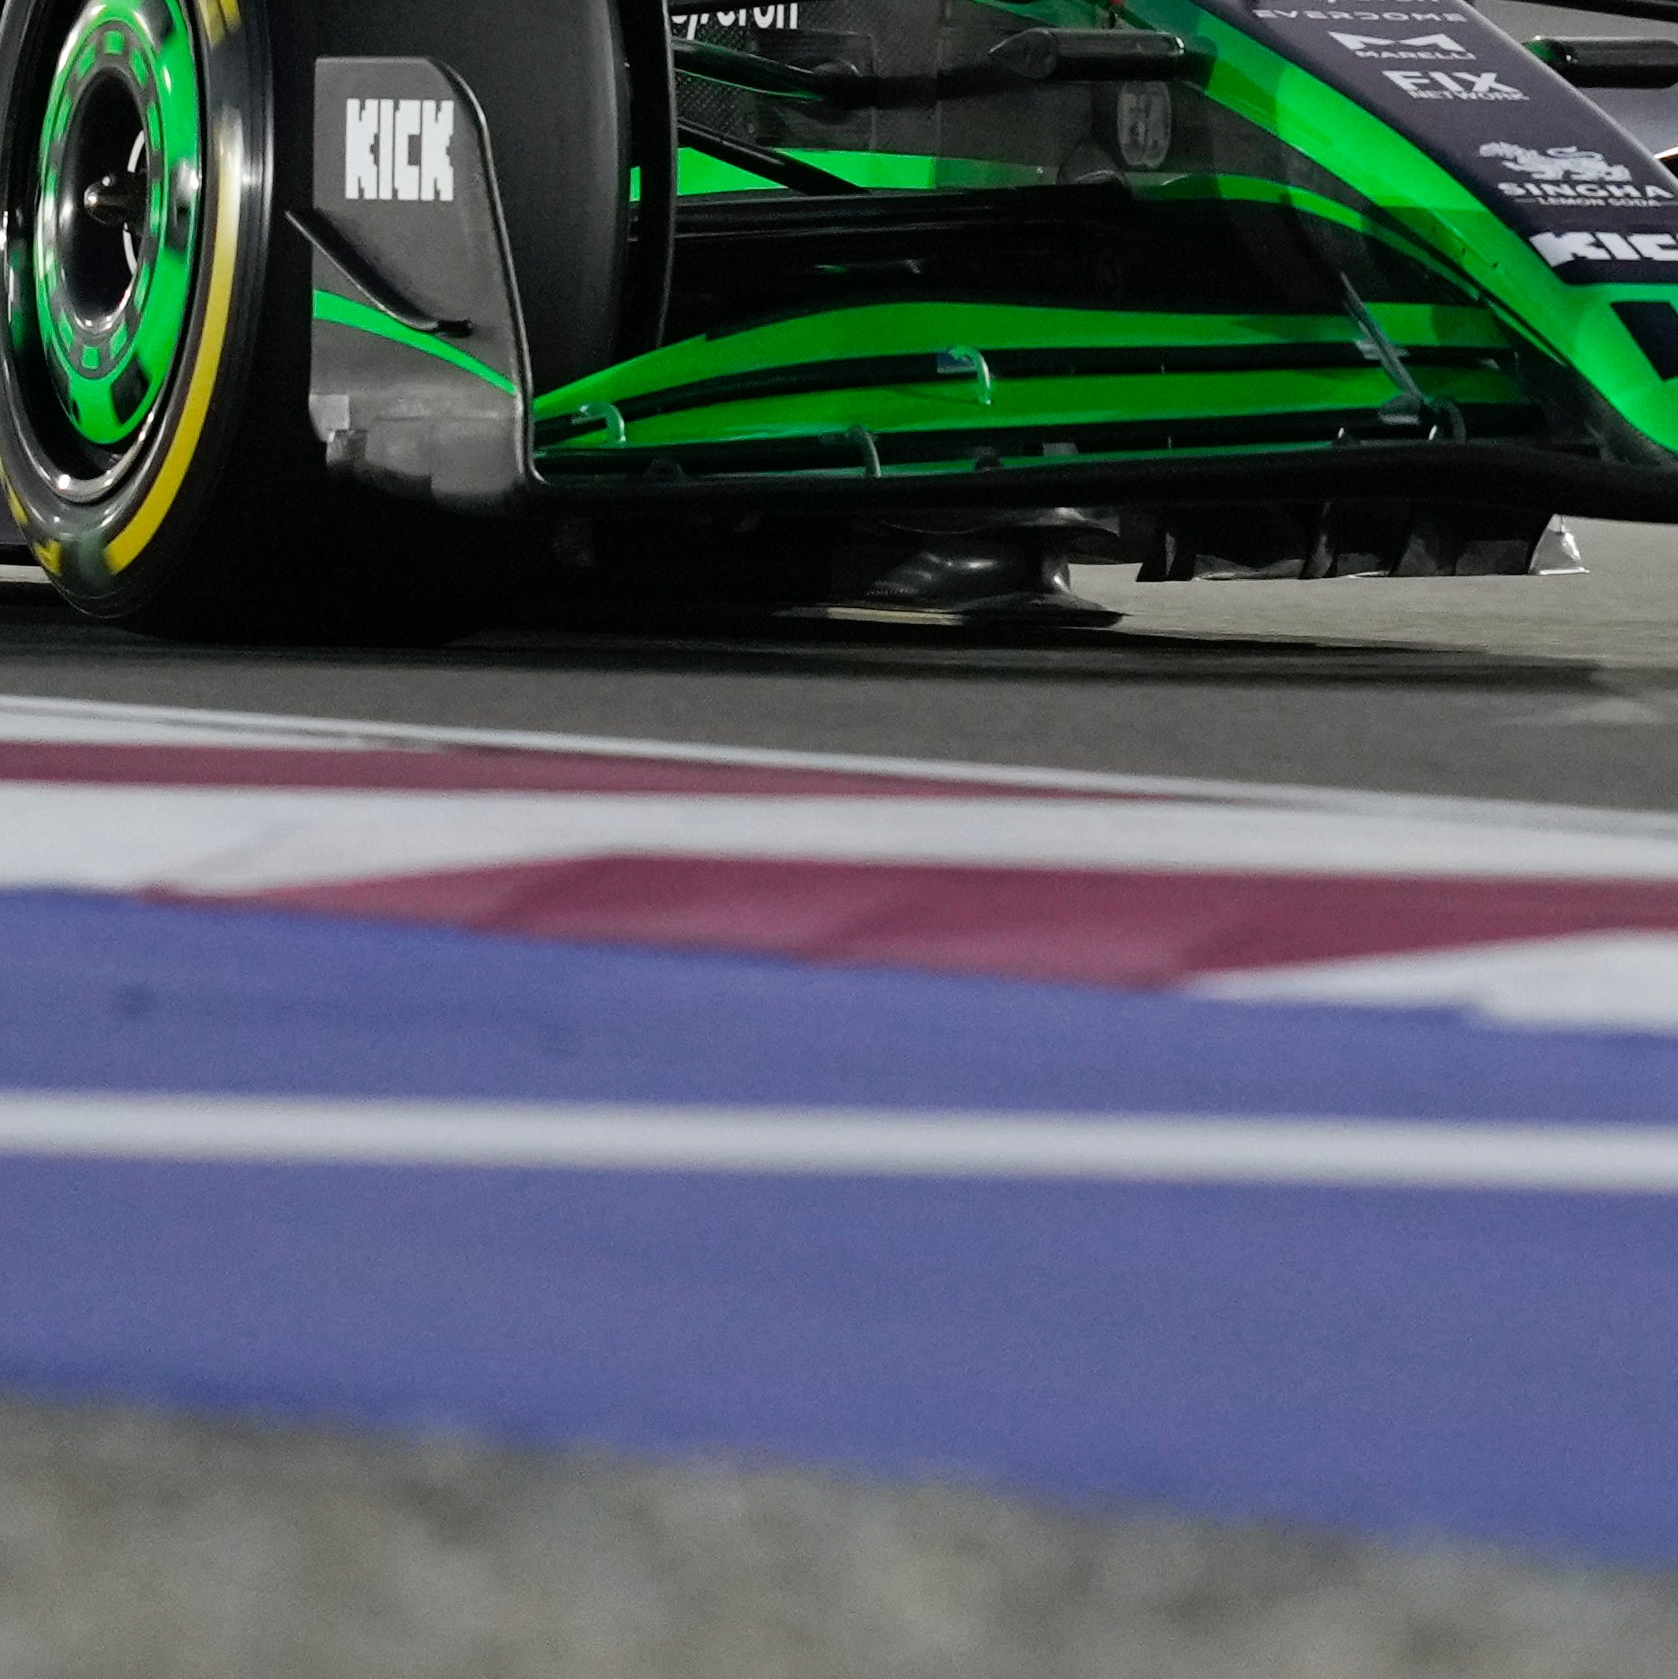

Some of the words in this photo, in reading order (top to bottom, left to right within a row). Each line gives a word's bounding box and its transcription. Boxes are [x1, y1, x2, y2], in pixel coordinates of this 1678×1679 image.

[1354, 50, 1477, 61] MARELLI
[1382, 70, 1524, 93] FIX
[344, 97, 455, 203] KICK
[1497, 181, 1675, 199] SINGHA
